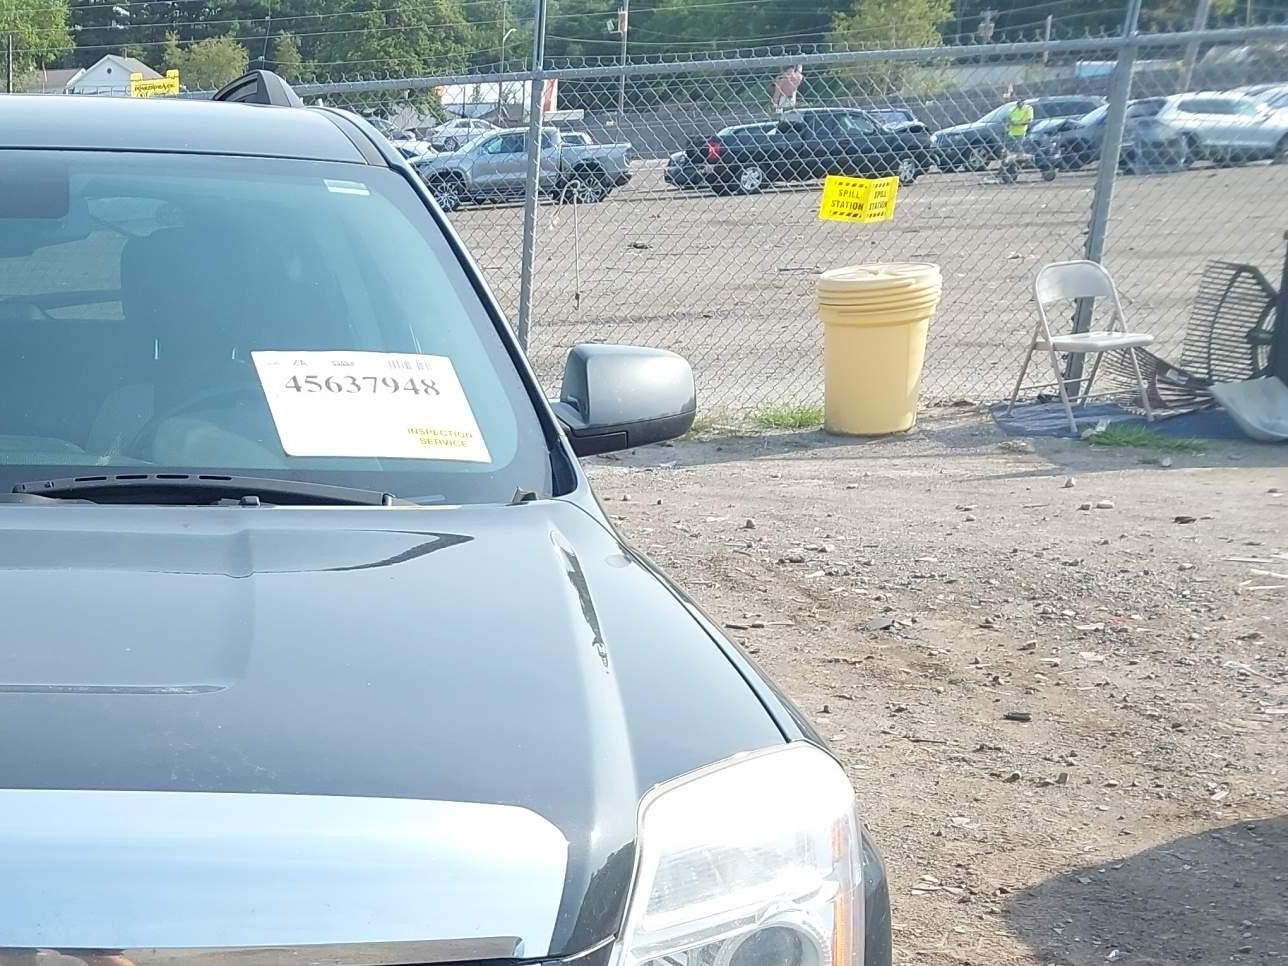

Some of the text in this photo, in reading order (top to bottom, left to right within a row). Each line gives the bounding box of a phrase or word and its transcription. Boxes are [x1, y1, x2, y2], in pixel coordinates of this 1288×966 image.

[838, 189, 860, 199] SPILL
[830, 200, 865, 211] STATION
[284, 375, 441, 397] 45637948
[407, 427, 474, 440] INSPECTION
[418, 437, 470, 448] SERVICE
